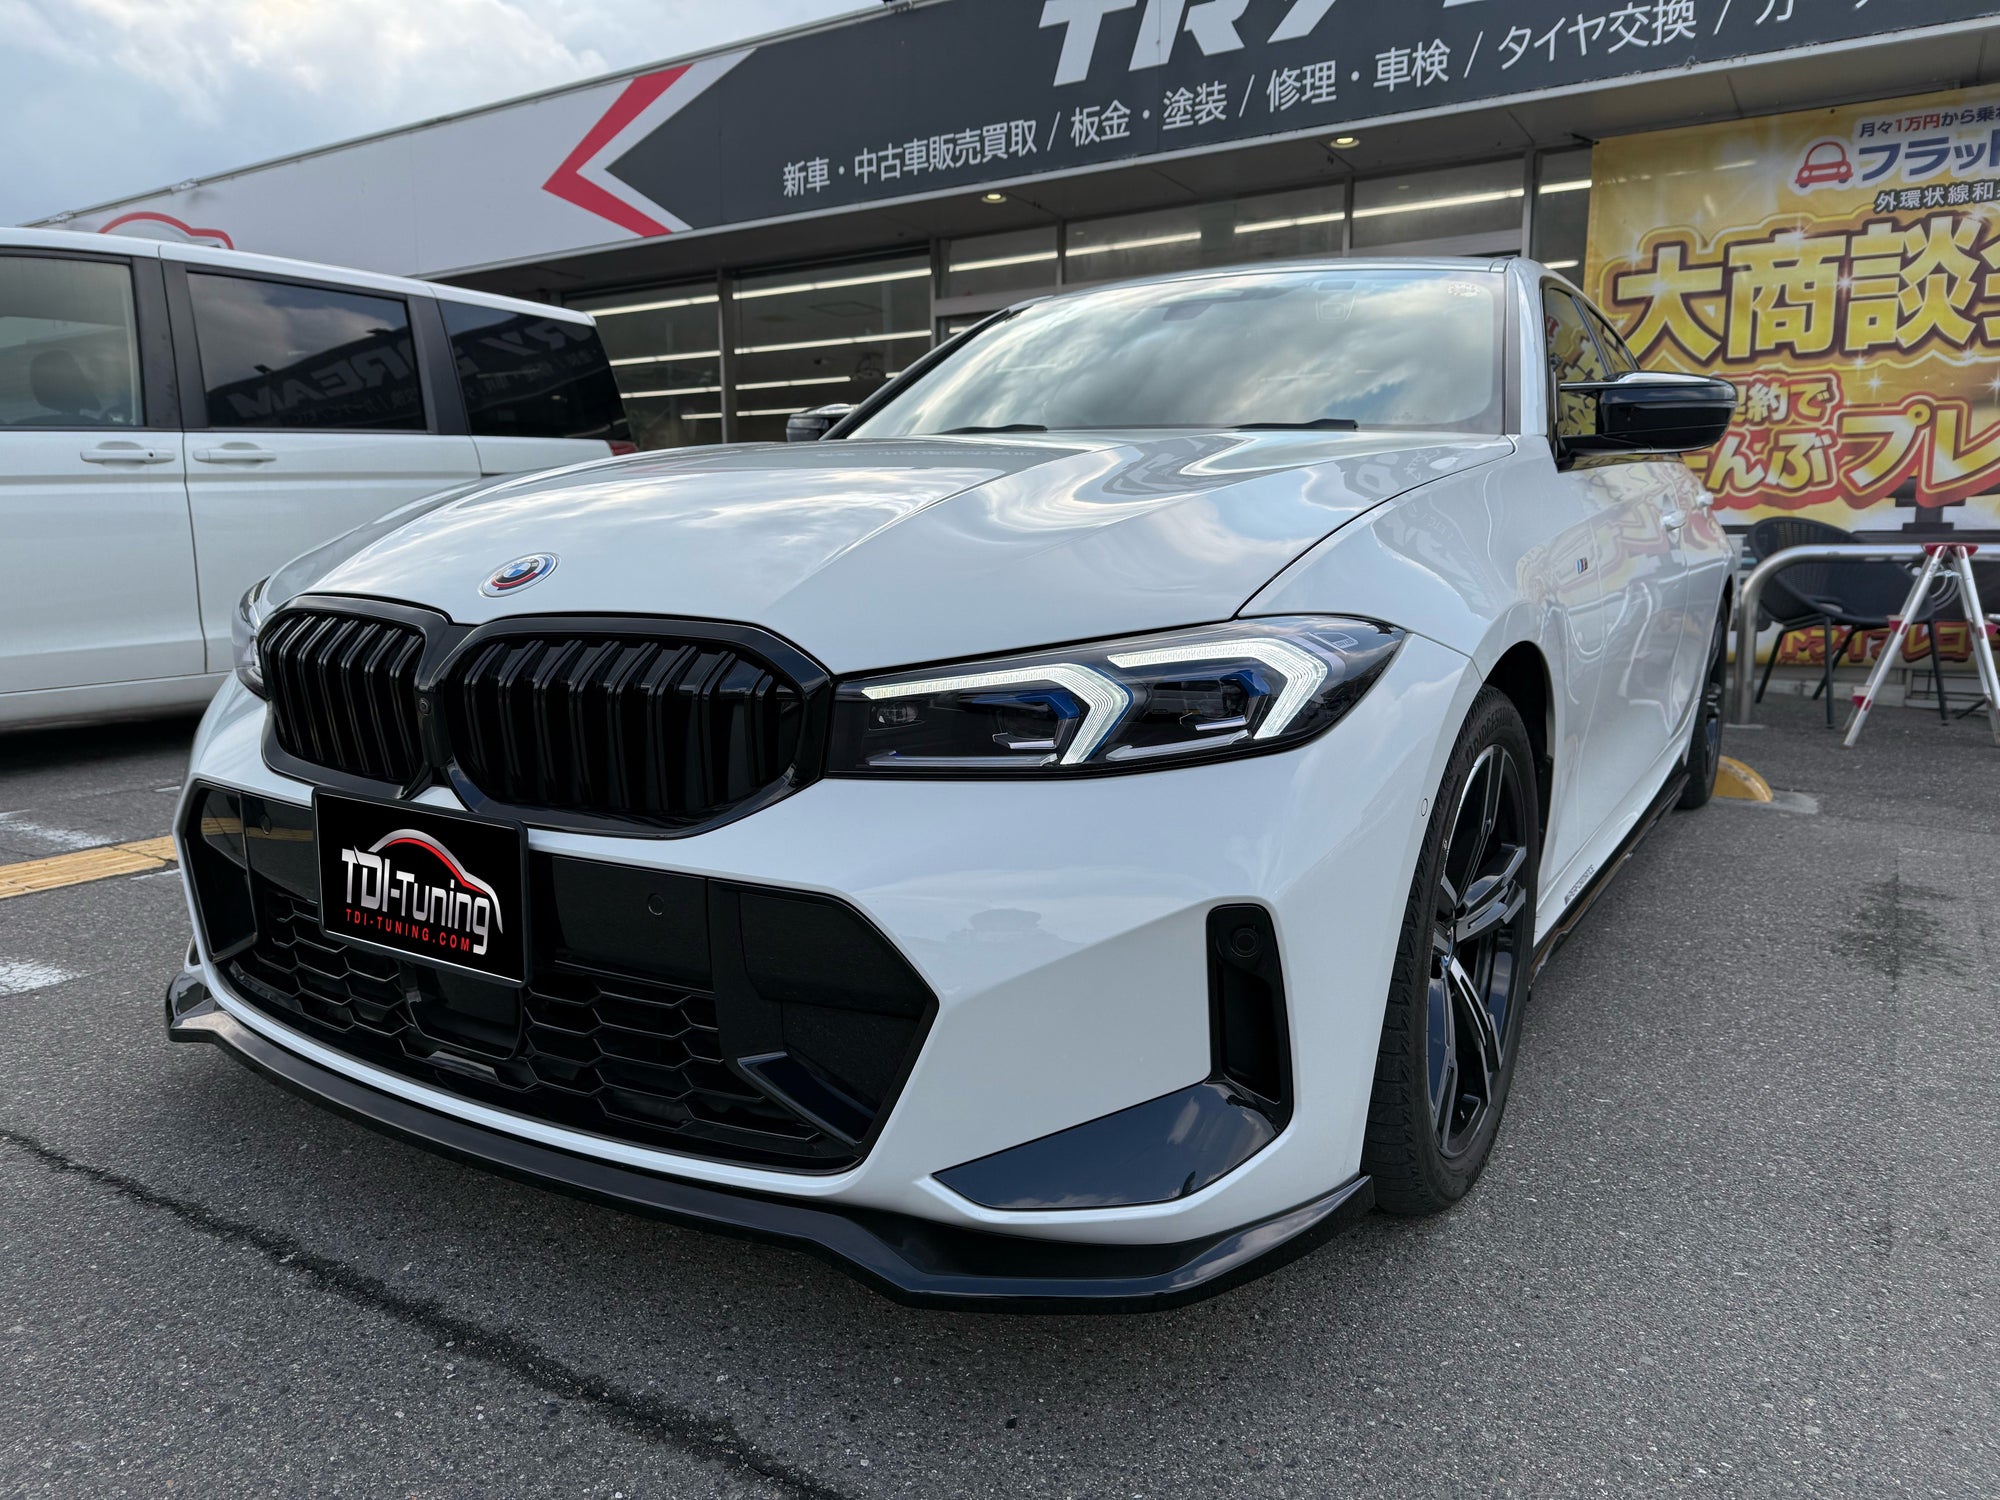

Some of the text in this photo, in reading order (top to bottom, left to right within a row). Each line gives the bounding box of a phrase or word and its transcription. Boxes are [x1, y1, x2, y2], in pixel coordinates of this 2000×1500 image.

[1070, 81, 1228, 147] 板金・塗装
[1266, 38, 1451, 113] 修理・車検
[1497, 0, 1697, 70] タイヤ交換
[1876, 181, 2000, 212] 外環状線和
[341, 846, 491, 956] TDI-Tuning
[345, 908, 470, 952] TDI-TUNING.COM
